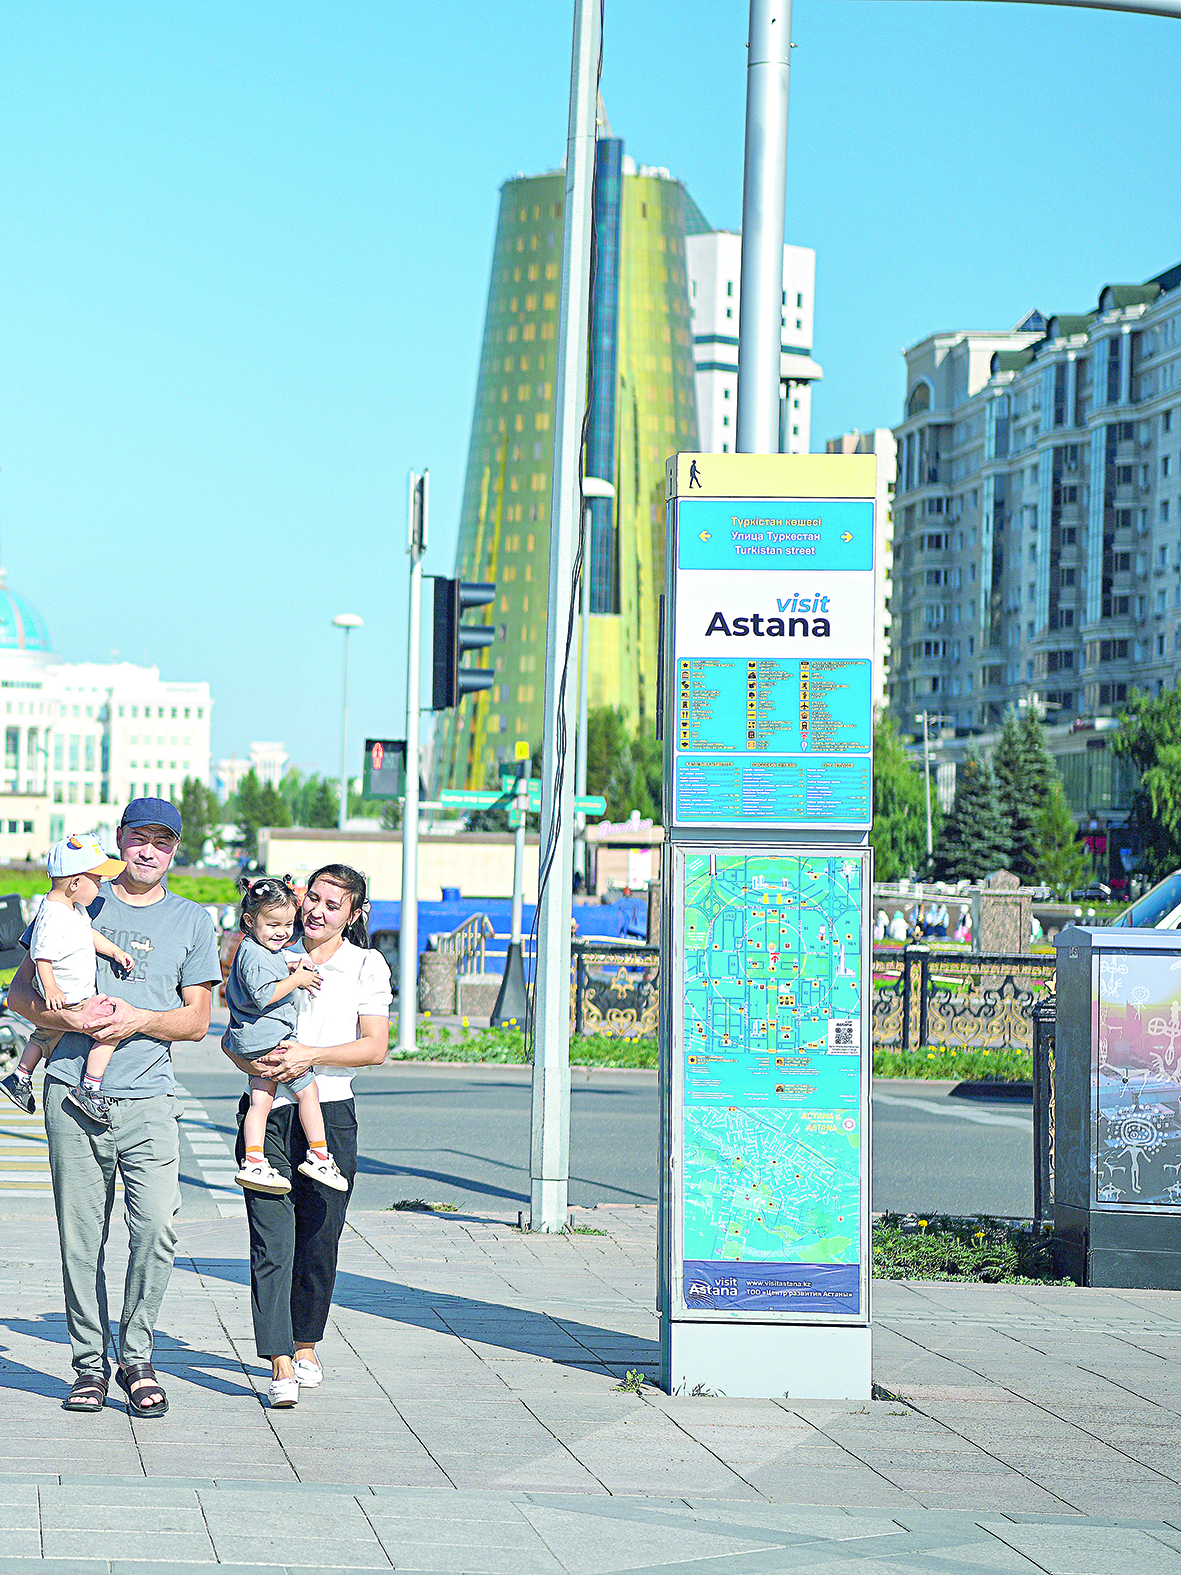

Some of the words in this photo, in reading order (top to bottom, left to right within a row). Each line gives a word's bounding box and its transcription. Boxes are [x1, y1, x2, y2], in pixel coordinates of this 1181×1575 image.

[731, 516, 783, 528] Түркістан
[785, 517, 822, 526] көшесі
[731, 531, 764, 541] Улица
[766, 531, 821, 542] Туркестан
[734, 545, 783, 555] Turkistan
[785, 546, 816, 555] street
[776, 592, 831, 613] visit
[704, 611, 831, 637] Astana
[714, 1276, 738, 1287] visit
[746, 1280, 812, 1288] www.visitastana.kz
[689, 1284, 738, 1296] Astana
[788, 1290, 822, 1298] развития
